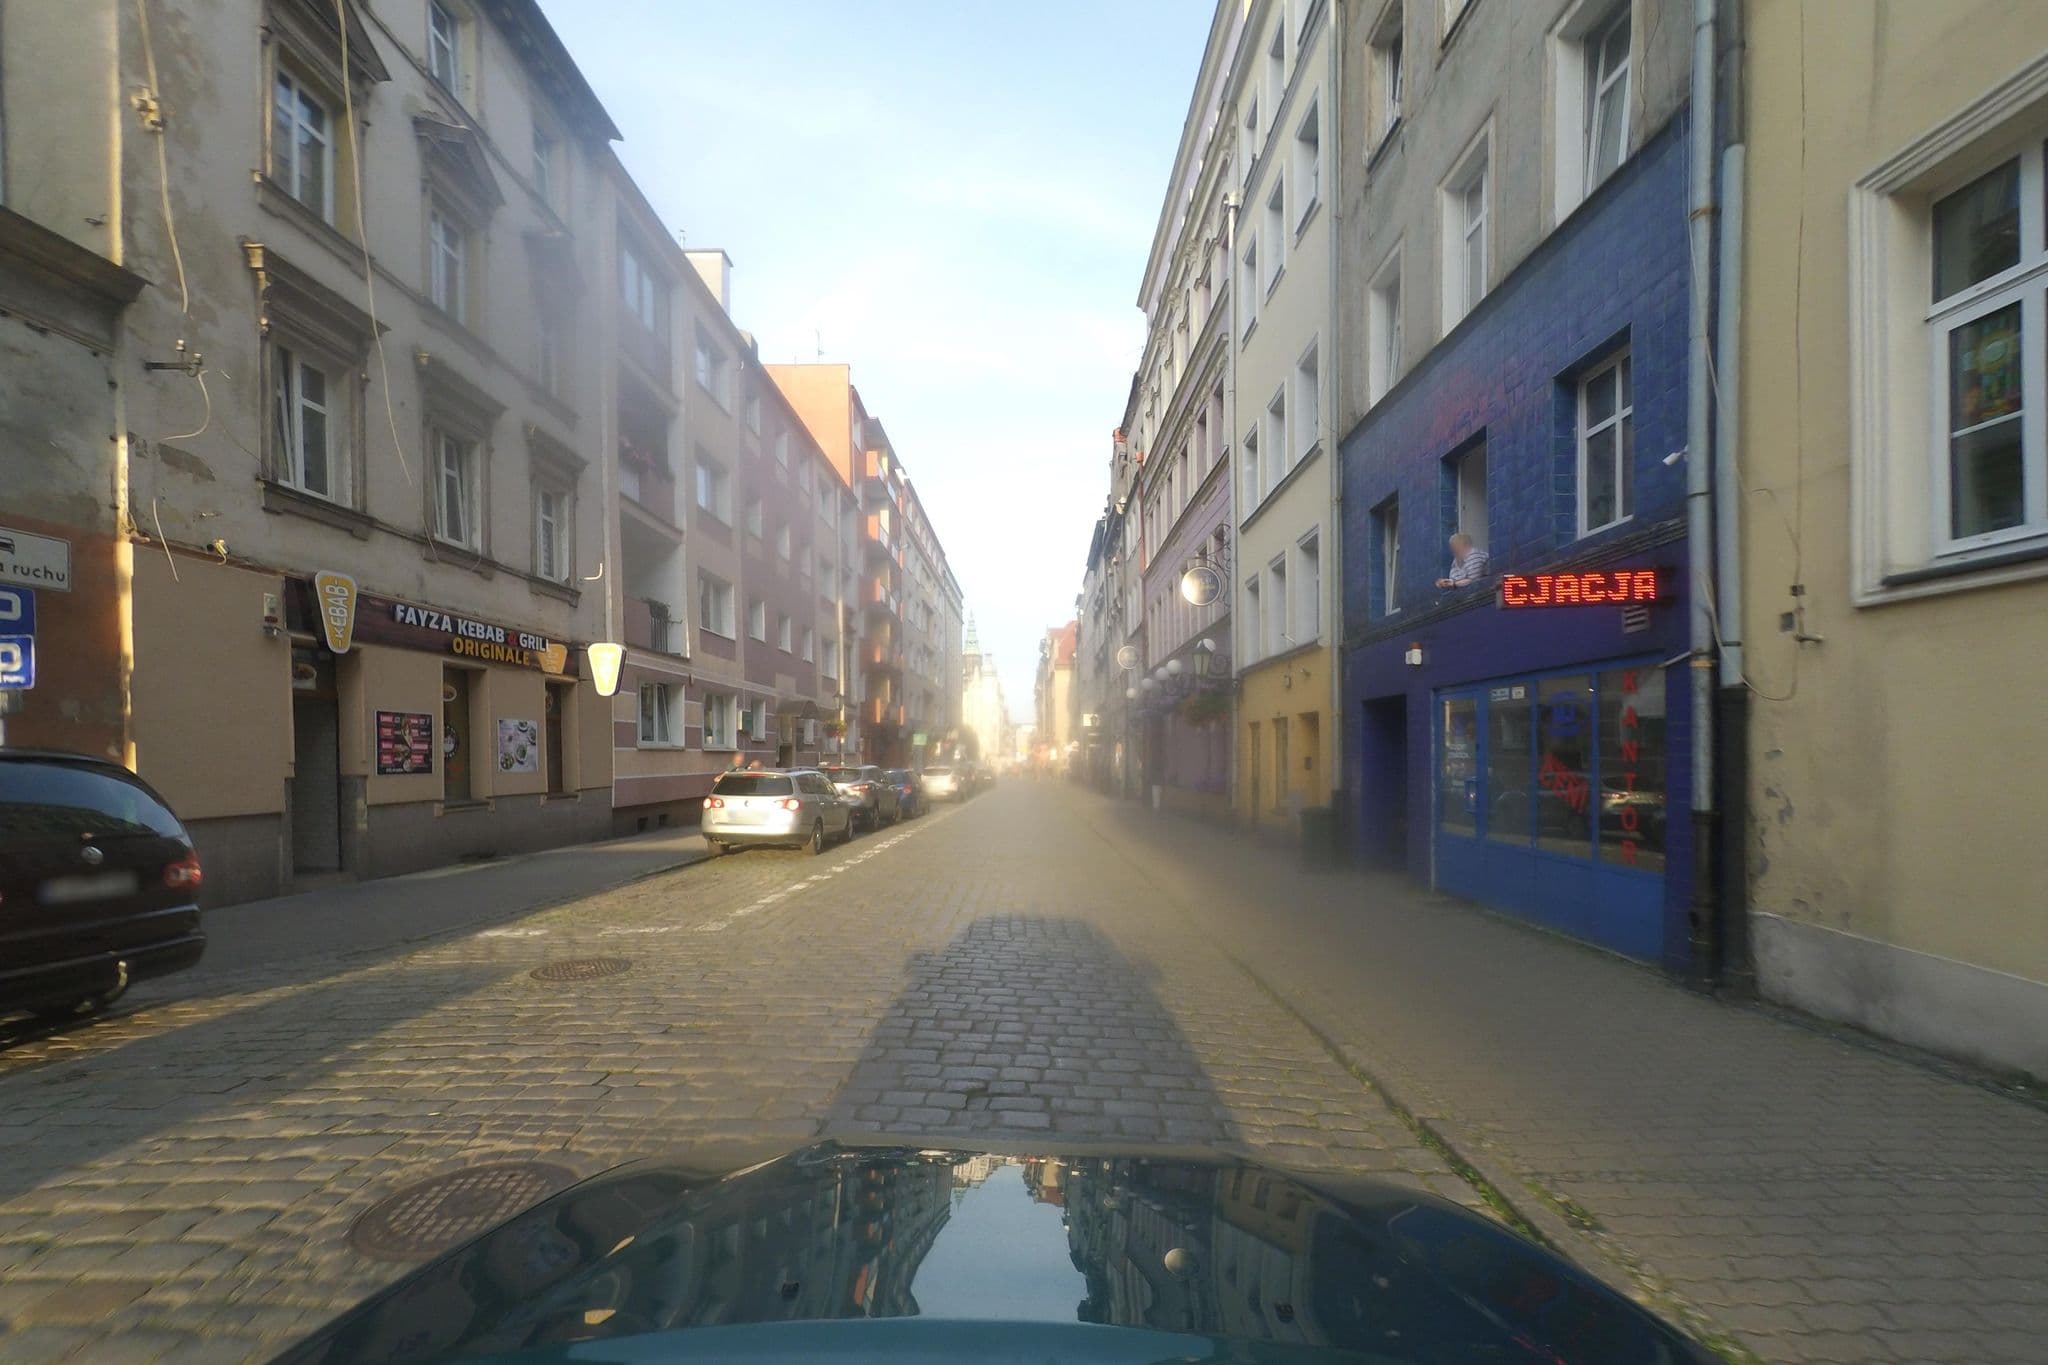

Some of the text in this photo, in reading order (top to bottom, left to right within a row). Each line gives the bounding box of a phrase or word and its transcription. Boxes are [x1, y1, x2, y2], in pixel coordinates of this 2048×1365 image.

[12, 564, 65, 582] ruchu
[325, 584, 349, 638] KEBAB
[395, 604, 452, 633] FAYZA
[457, 618, 505, 643] KEBAB
[452, 637, 530, 666] ORIGINALE
[1621, 671, 1638, 865] KANTOR
